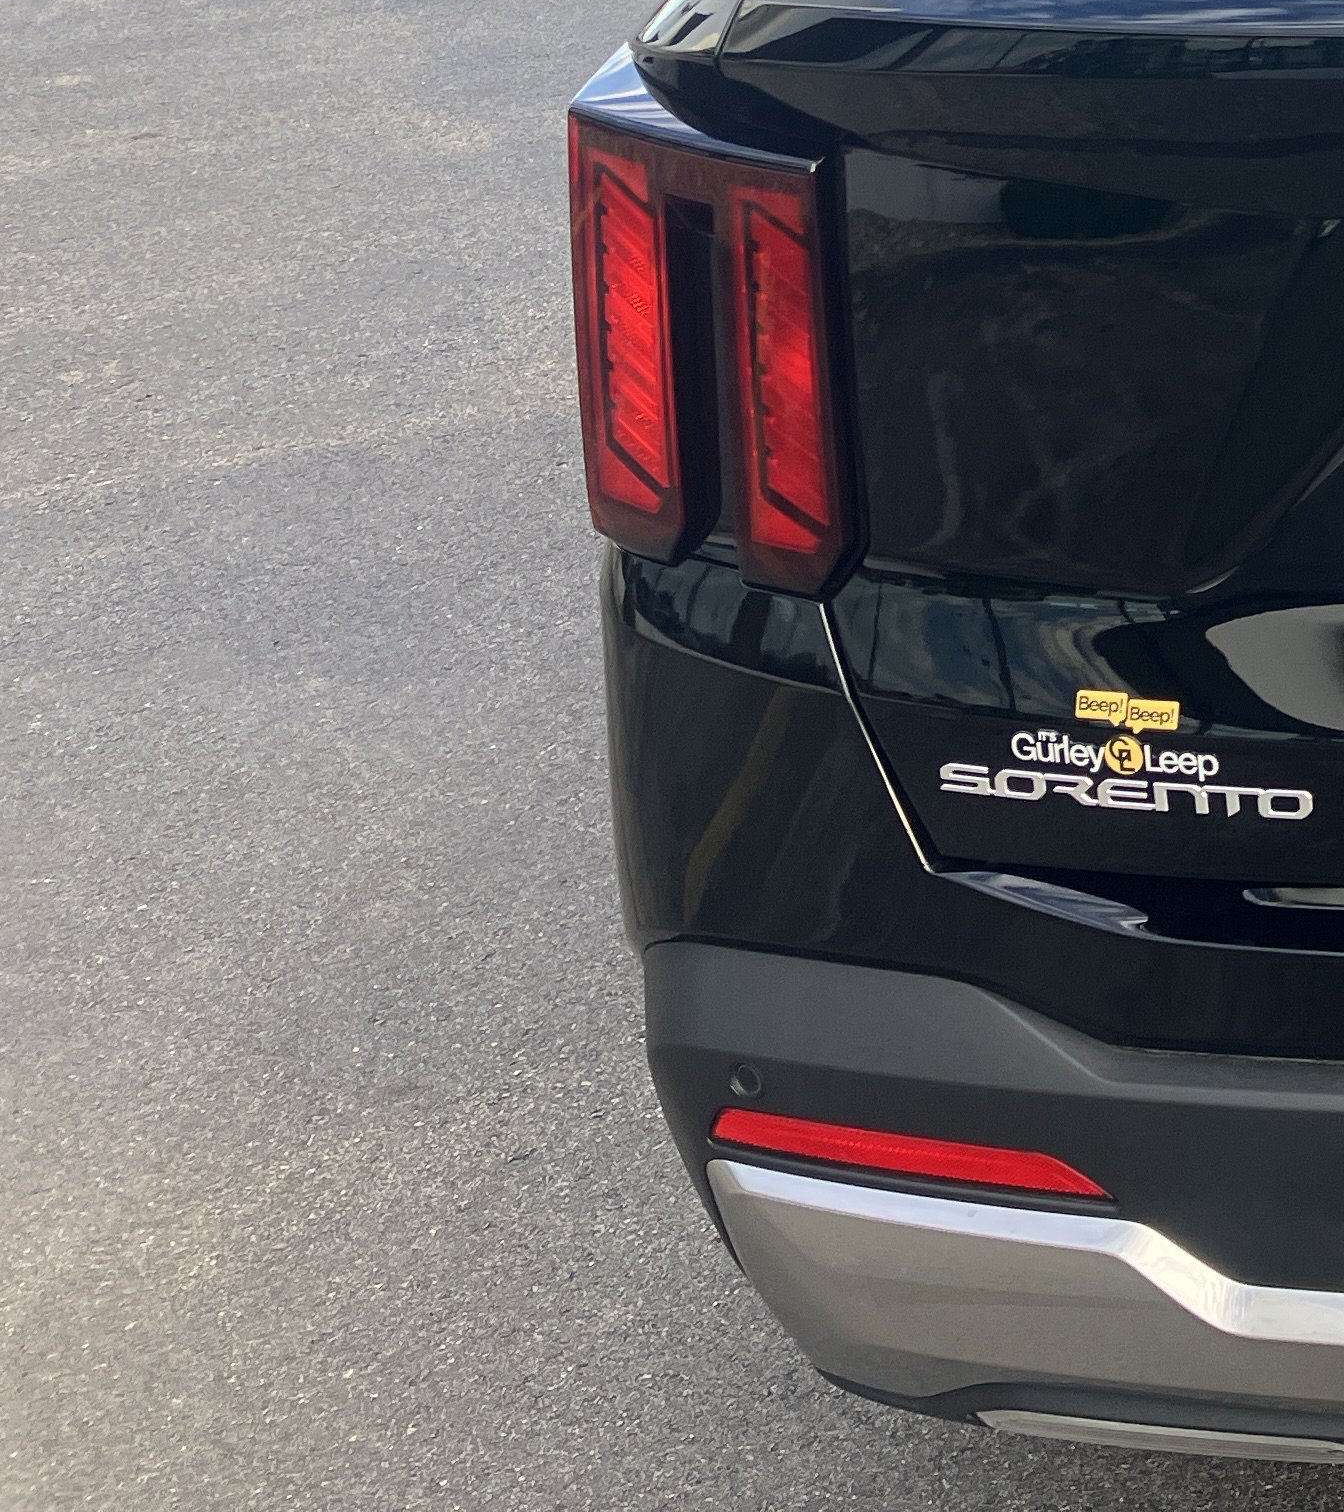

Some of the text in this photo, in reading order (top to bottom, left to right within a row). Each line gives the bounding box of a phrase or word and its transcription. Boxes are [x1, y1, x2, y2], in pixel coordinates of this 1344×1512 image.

[1078, 695, 1175, 725] Beep! Beep!
[1011, 732, 1104, 773] Gurley
[1144, 744, 1219, 782] Leep
[939, 762, 1313, 820] SORENTO
